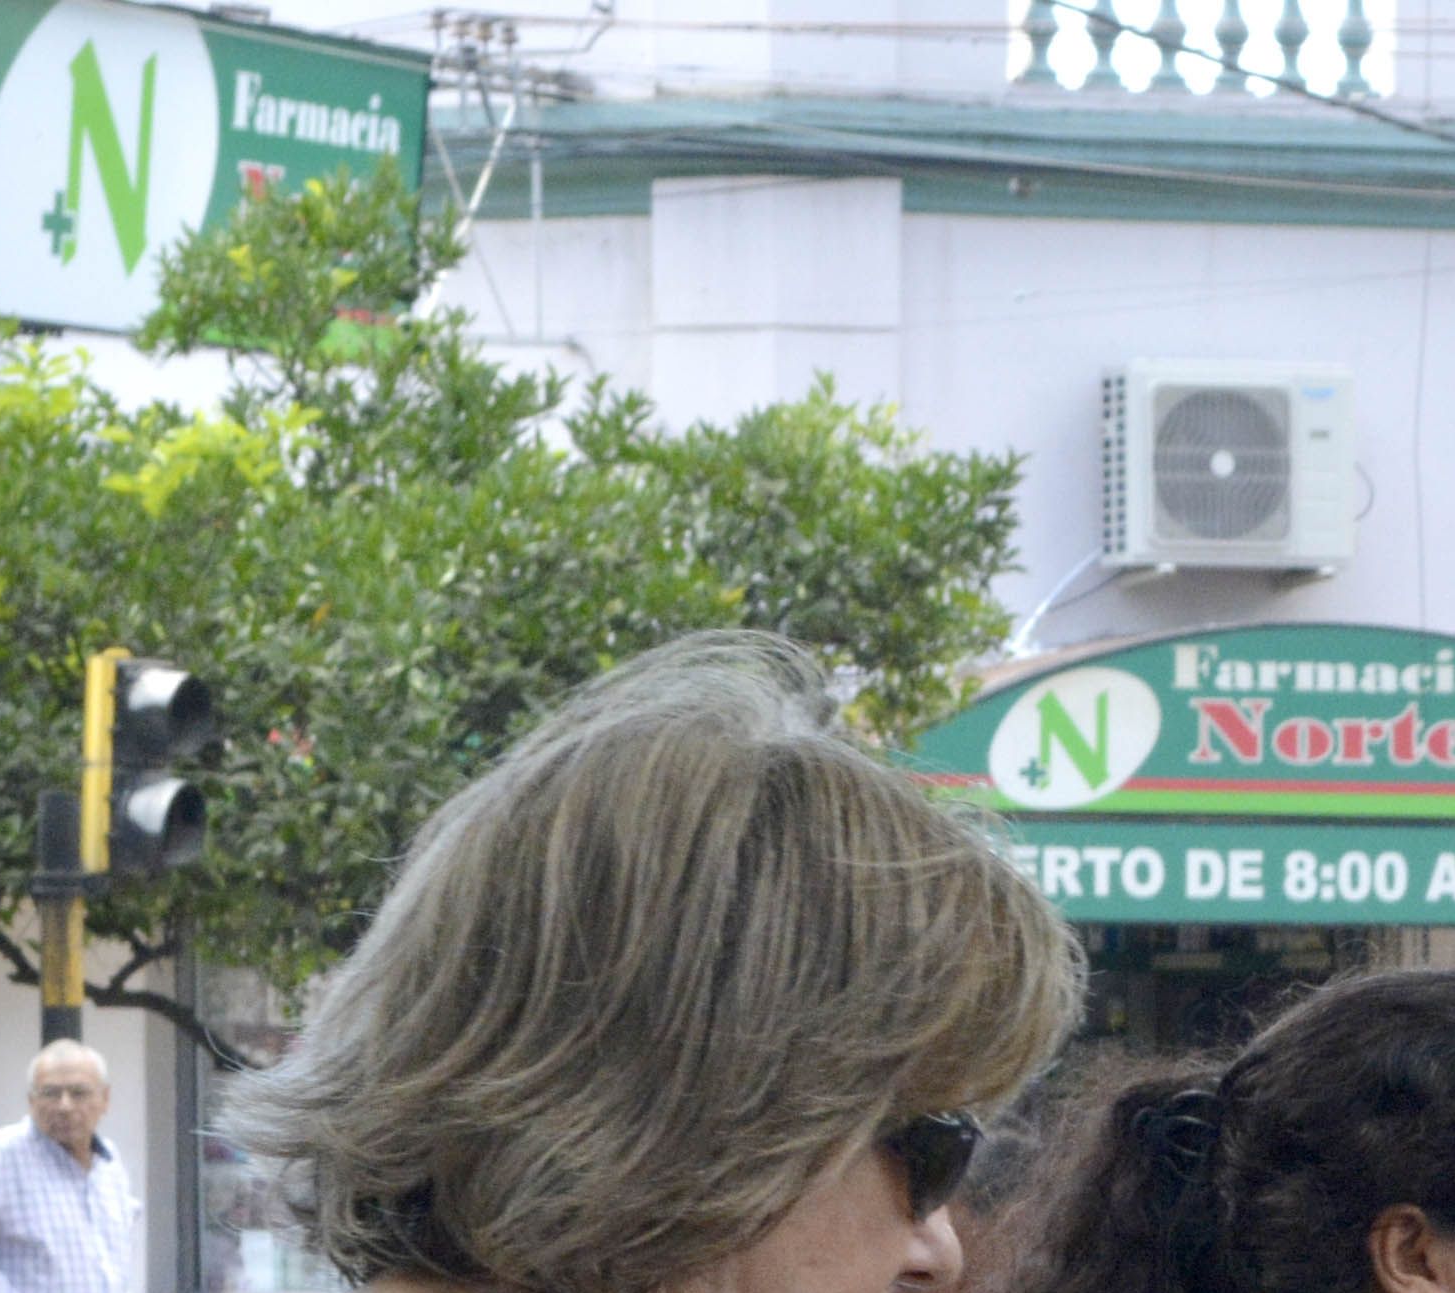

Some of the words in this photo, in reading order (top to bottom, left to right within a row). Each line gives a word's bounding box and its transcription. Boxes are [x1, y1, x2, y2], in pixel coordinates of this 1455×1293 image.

[232, 69, 401, 156] Farmacia
[1185, 849, 1265, 899] DE
[1283, 851, 1409, 902] 8:00
